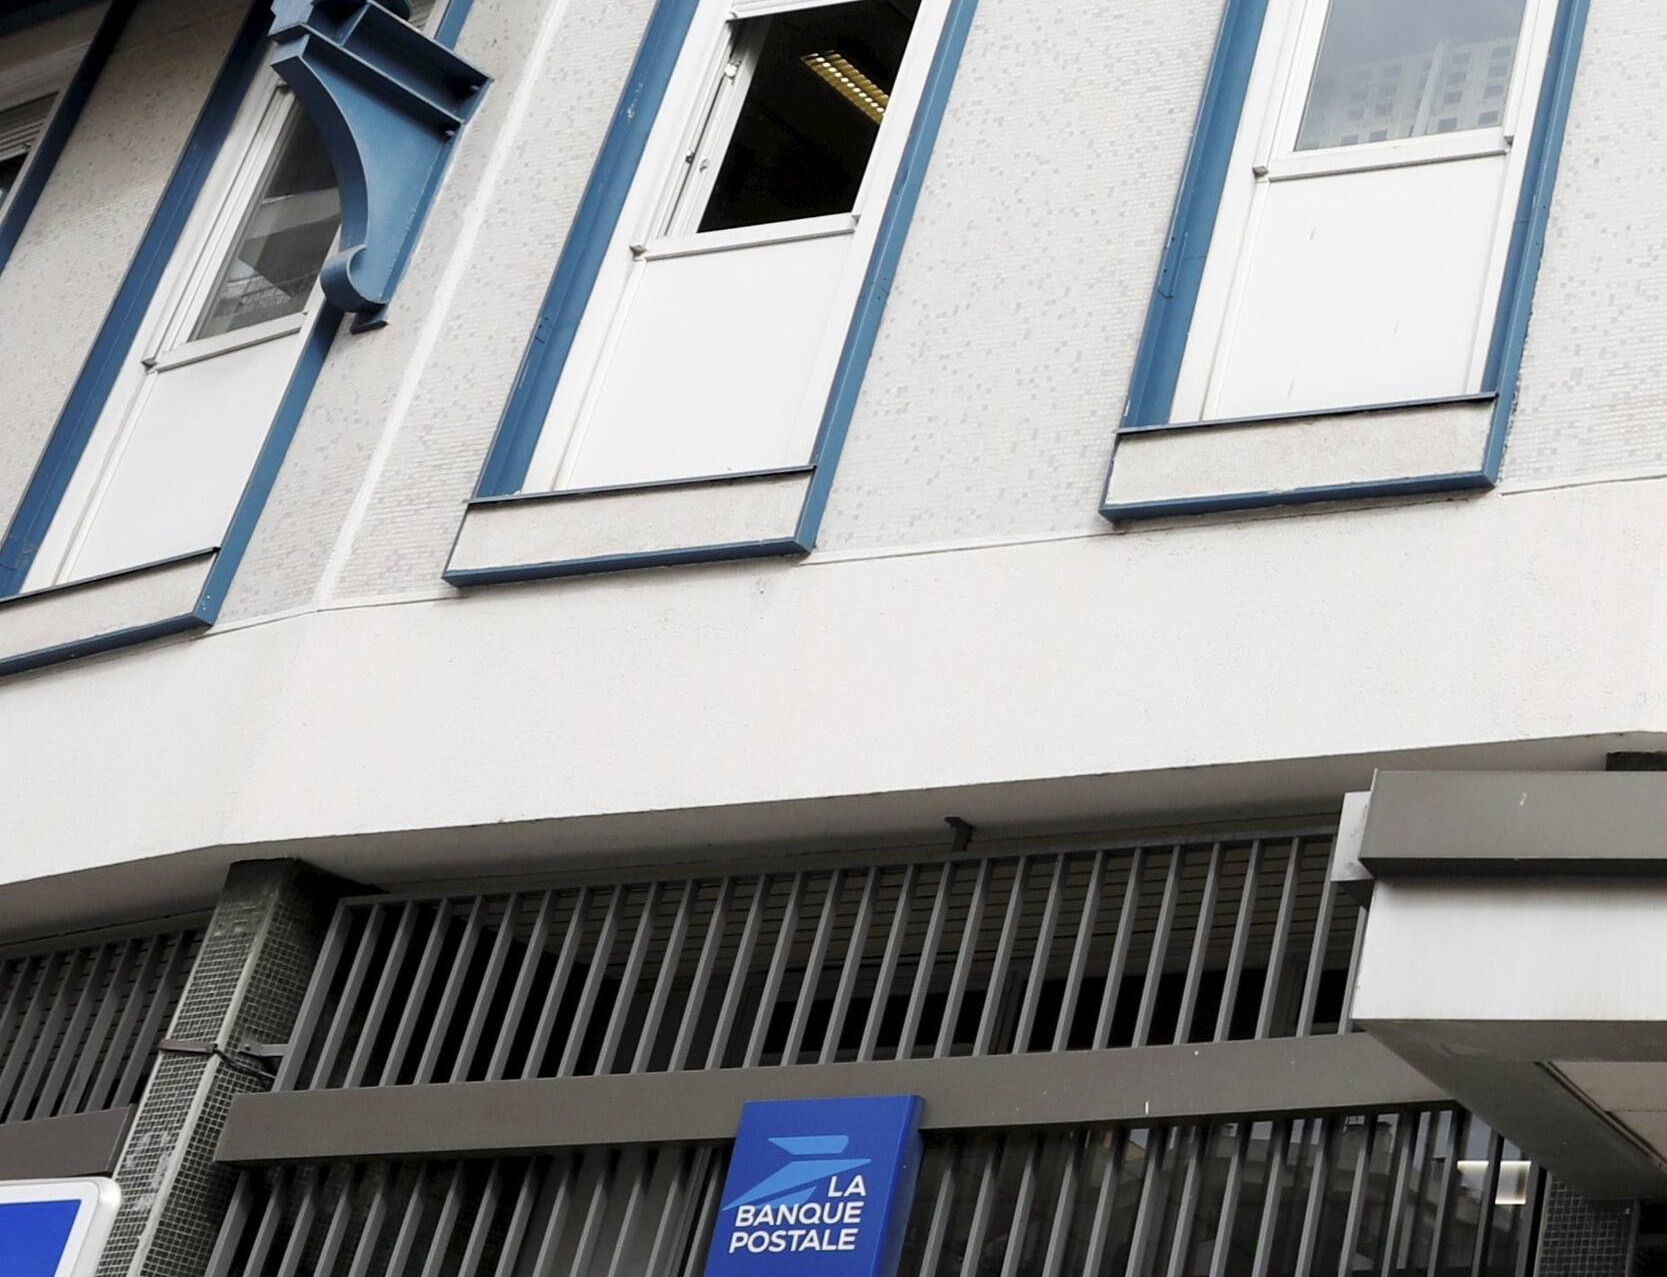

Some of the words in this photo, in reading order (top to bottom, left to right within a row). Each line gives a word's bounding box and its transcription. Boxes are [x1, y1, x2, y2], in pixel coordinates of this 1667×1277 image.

[827, 1175, 867, 1198] LA
[734, 1201, 865, 1227] BANQUE
[728, 1228, 860, 1254] POSTALE
